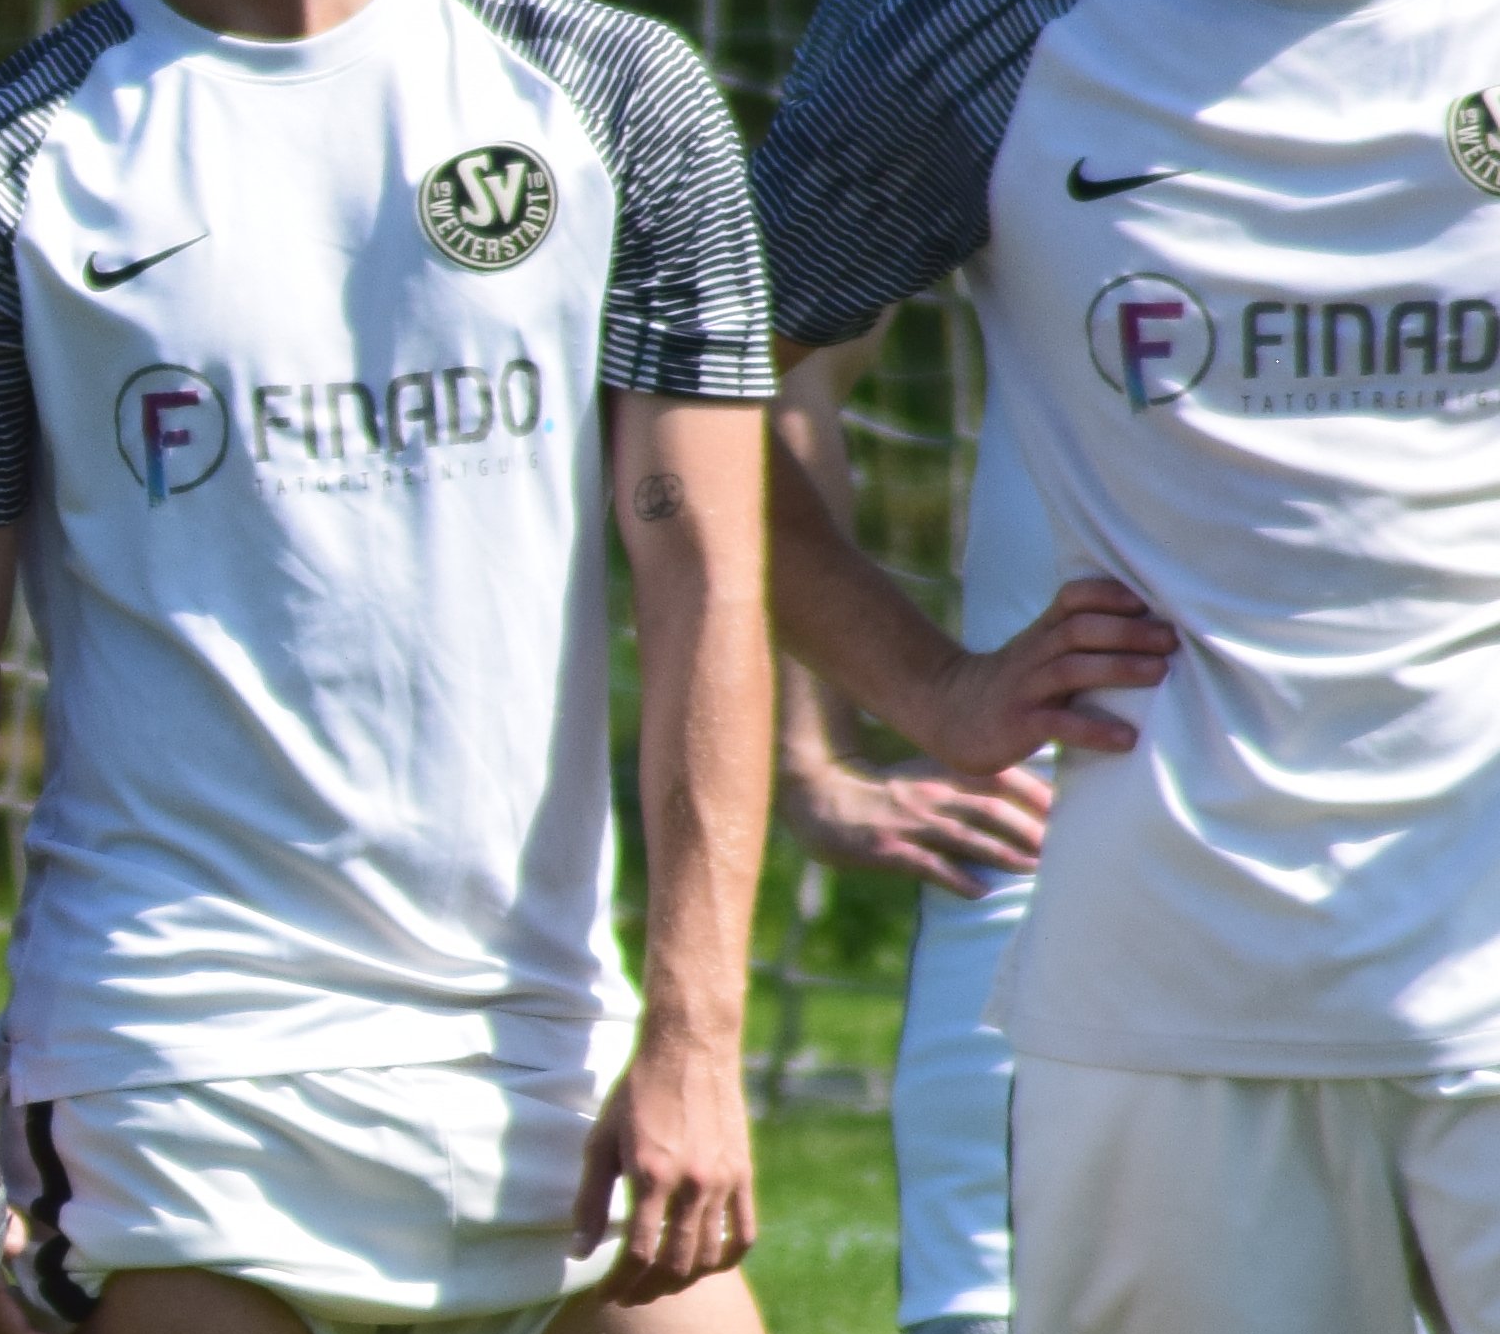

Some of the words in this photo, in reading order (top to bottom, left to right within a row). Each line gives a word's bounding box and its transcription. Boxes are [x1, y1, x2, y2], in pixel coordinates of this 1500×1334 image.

[431, 181, 453, 198] 19
[1457, 125, 1500, 185] WEIT
[457, 154, 525, 226] SV
[430, 192, 549, 261] WEITERSTADT
[1118, 302, 1184, 414] F
[141, 390, 199, 507] F
[254, 451, 540, 496] TATORTREINIGUG
